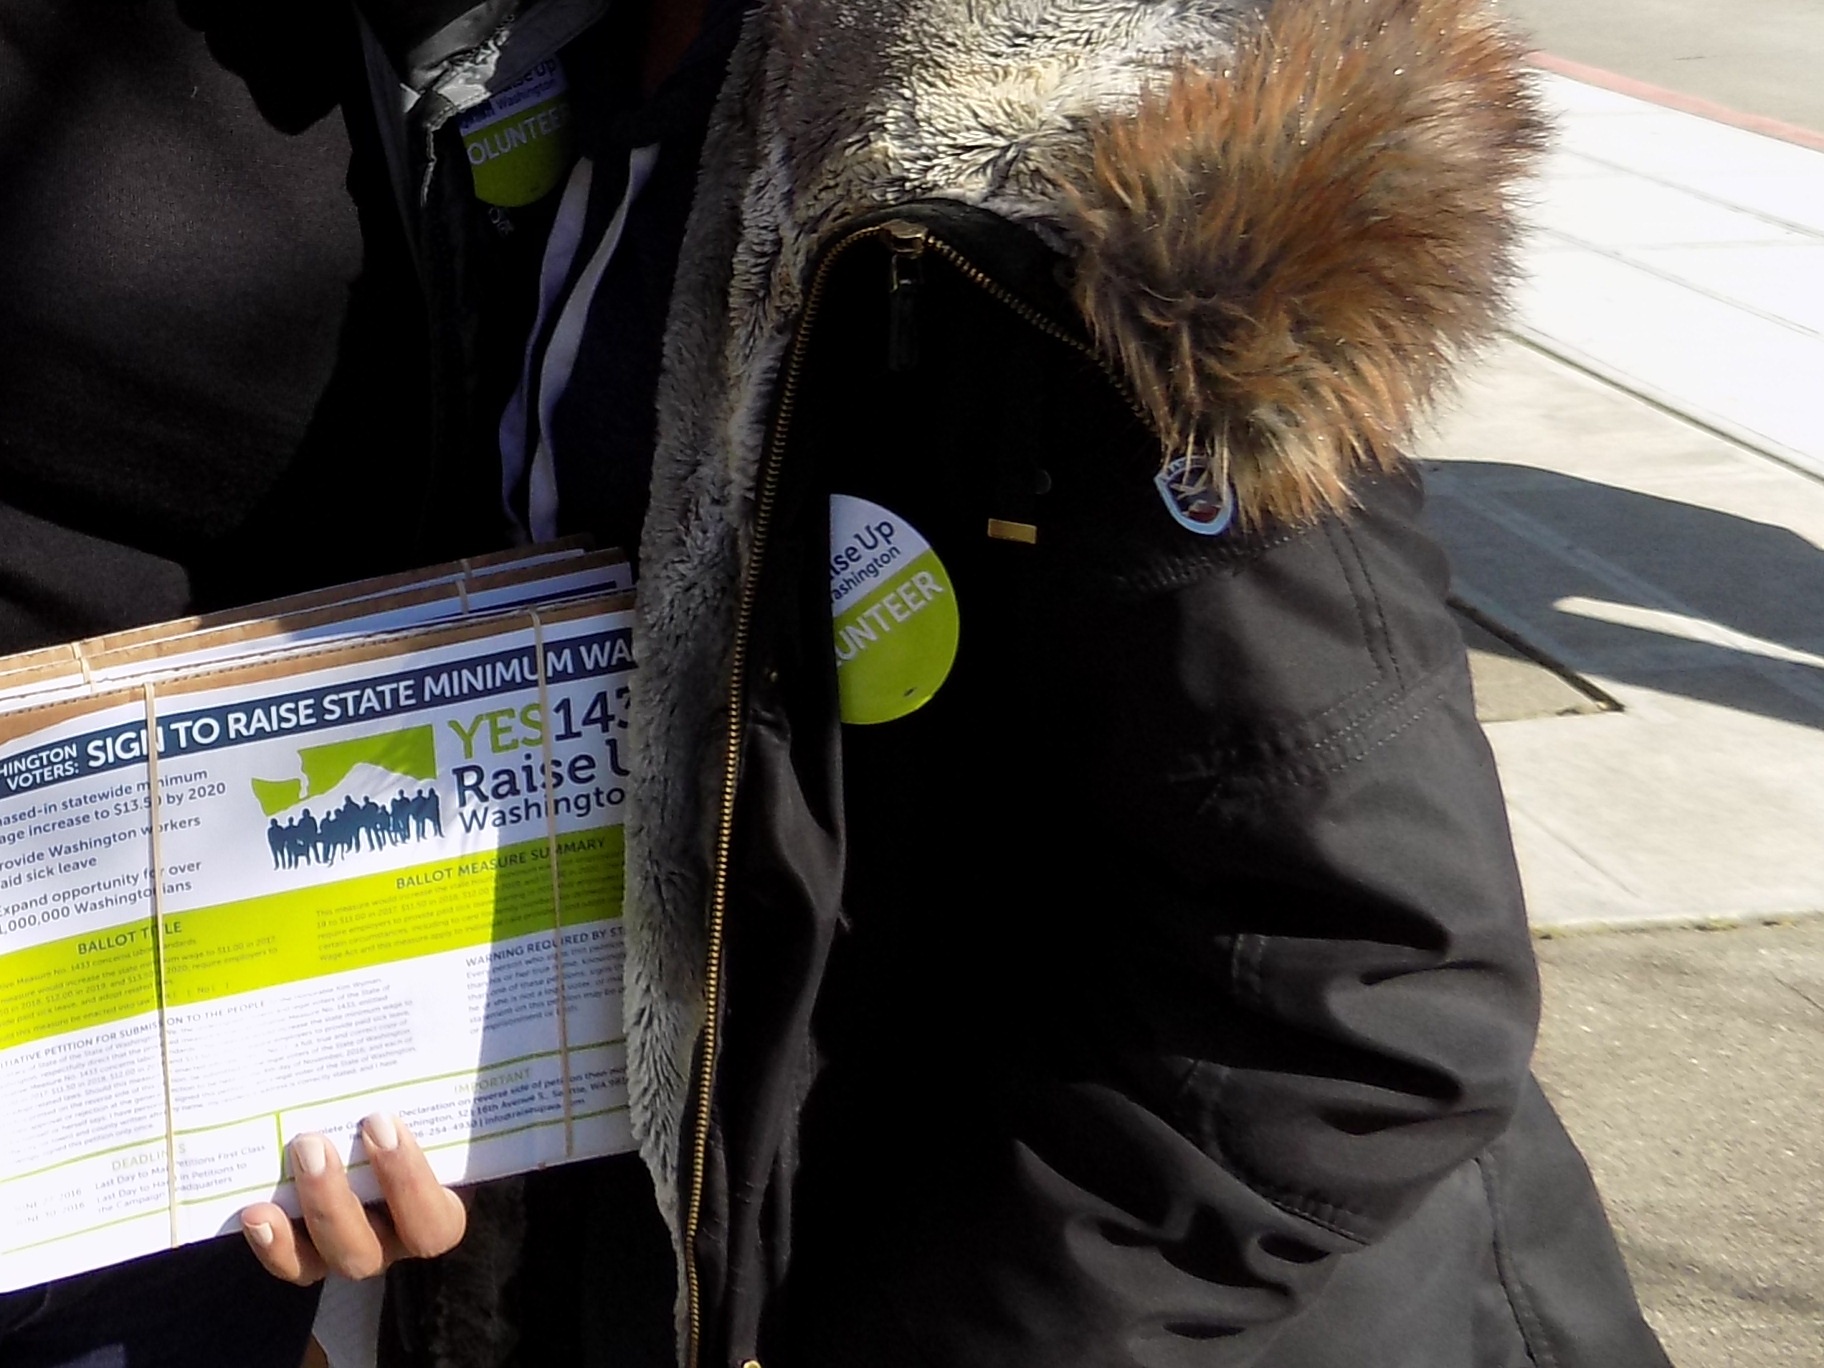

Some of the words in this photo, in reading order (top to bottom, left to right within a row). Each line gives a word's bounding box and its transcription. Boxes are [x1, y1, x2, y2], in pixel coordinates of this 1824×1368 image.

[854, 520, 895, 551] Up
[831, 545, 901, 605] ashington
[836, 570, 945, 669] UNTEER
[86, 723, 165, 768] SIGN
[170, 717, 220, 749] TO
[227, 698, 317, 739] RAISE
[322, 678, 417, 721] STATE
[423, 648, 574, 703] MINIMUM
[5, 762, 79, 791] VOTERS:
[62, 783, 133, 811] statewide
[137, 768, 209, 795] mnimum
[451, 752, 597, 808] Raise
[29, 813, 92, 837] increase
[94, 807, 111, 822] to
[165, 787, 185, 807] by
[188, 781, 227, 802] 2020
[457, 786, 626, 834] Washingto
[48, 825, 138, 859] Washington
[26, 865, 55, 884] sick
[58, 855, 98, 875] leave
[51, 868, 140, 904] opportunity
[168, 860, 202, 876] over
[395, 867, 453, 890] BALLOT
[457, 851, 527, 878] MEASURE
[77, 930, 136, 956] BALLOT
[140, 921, 182, 942] TILE
[465, 953, 524, 968] WARNING
[592, 929, 607, 941] BY
[44, 1036, 93, 1057] PETITION
[96, 1030, 116, 1044] FOR
[111, 1142, 186, 1172] DEADLINS
[116, 1172, 136, 1186] Day
[137, 1169, 148, 1179] to
[139, 1182, 150, 1192] to
